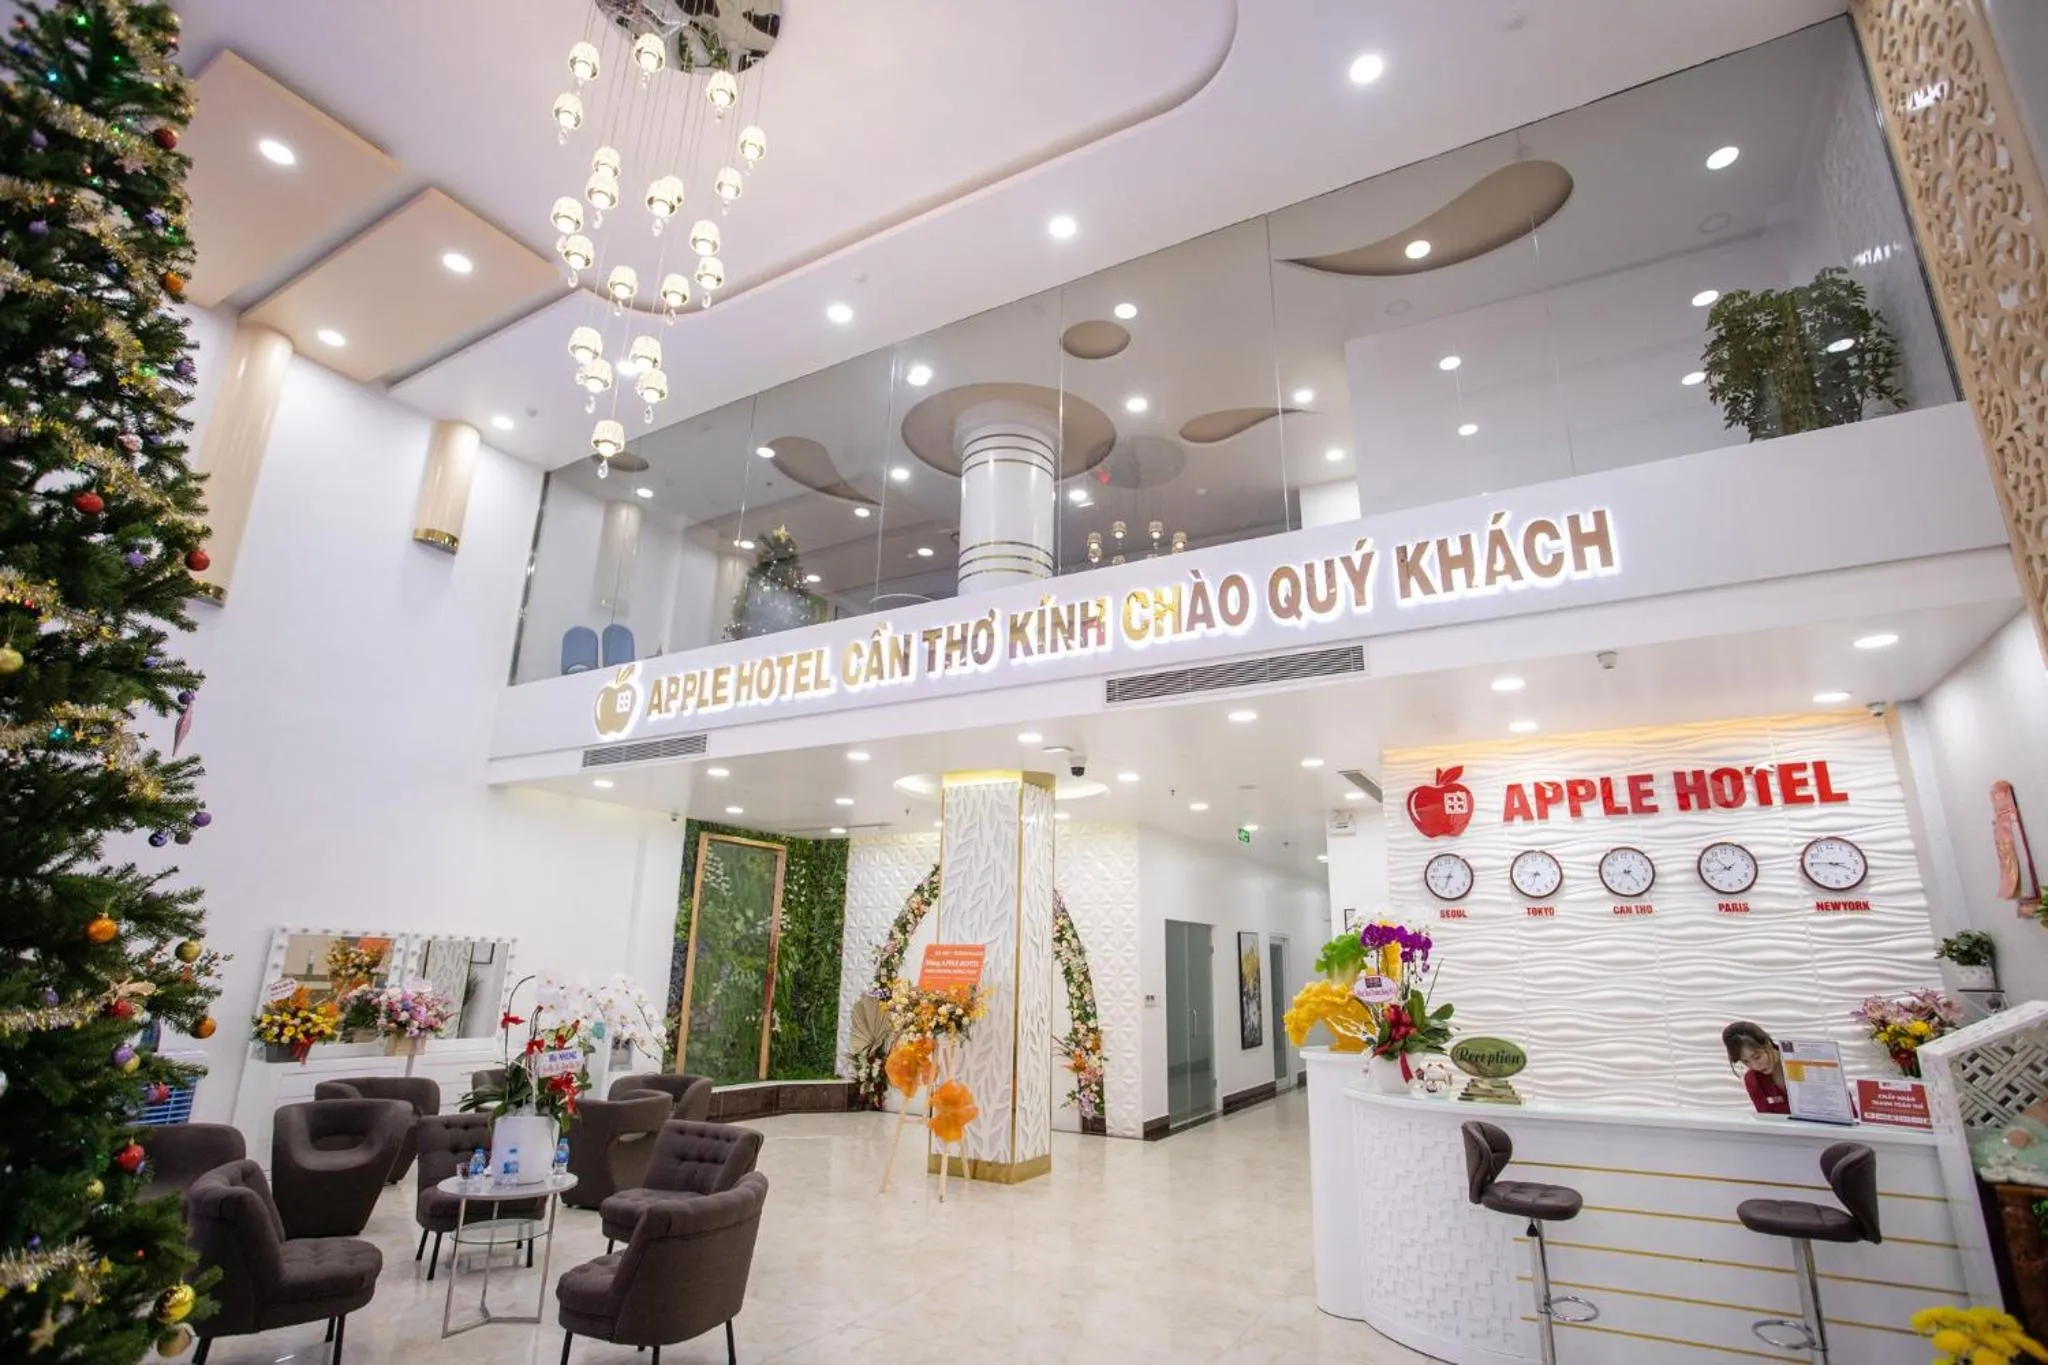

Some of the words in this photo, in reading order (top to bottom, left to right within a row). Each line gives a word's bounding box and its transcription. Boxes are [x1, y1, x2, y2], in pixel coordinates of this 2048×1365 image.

[646, 666, 731, 717] APPLE
[735, 649, 831, 702] HOTEL
[842, 622, 912, 686] CẦN
[922, 608, 996, 673] THƠ
[1009, 594, 1106, 659] KÍNH
[1121, 569, 1250, 641] CHÀO
[1268, 538, 1375, 621] QUÝ
[1396, 509, 1614, 600] KHÁCH
[1503, 774, 1659, 823] APPLE
[1673, 761, 1849, 811] HOTEL
[1613, 905, 1633, 915] CAN
[1635, 904, 1653, 914] THO
[1717, 902, 1750, 913] PARIS
[1815, 900, 1870, 911] NEWYORK
[1440, 908, 1468, 919] SEOUL
[1526, 907, 1555, 917] TOKYO
[1458, 1047, 1520, 1066] Reception
